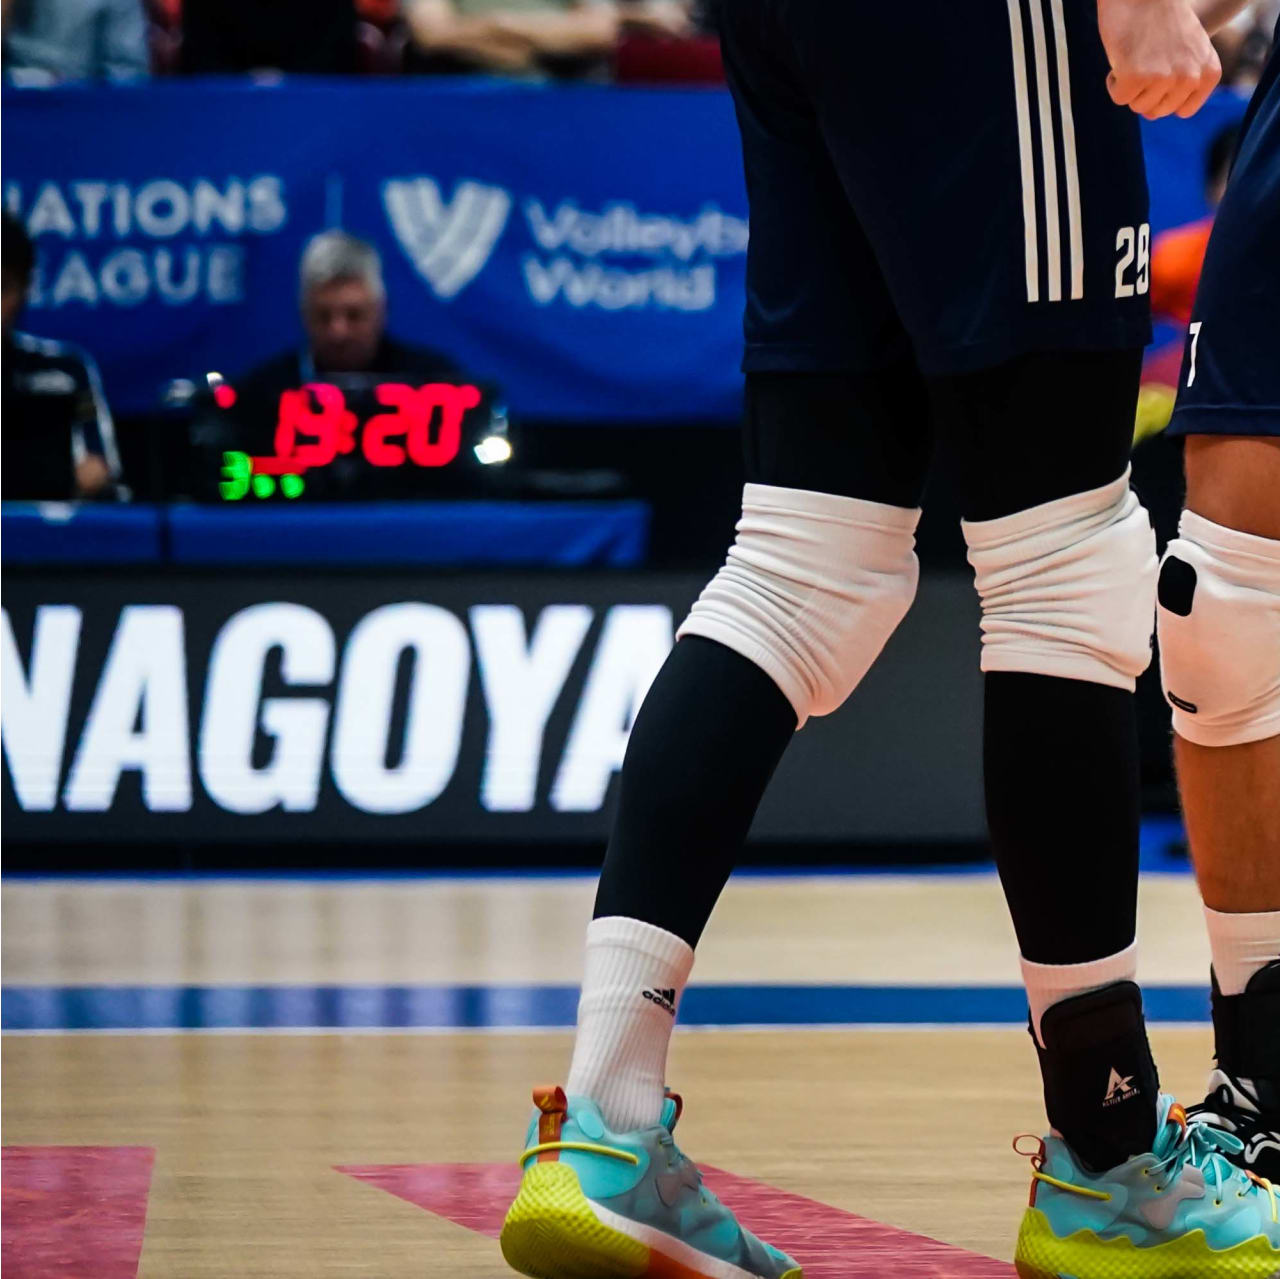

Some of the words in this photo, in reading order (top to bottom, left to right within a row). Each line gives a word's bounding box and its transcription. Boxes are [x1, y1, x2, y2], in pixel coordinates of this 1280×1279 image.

[524, 196, 748, 261] Volleyb
[1114, 223, 1150, 299] 29
[1, 601, 674, 814] NAGOYA
